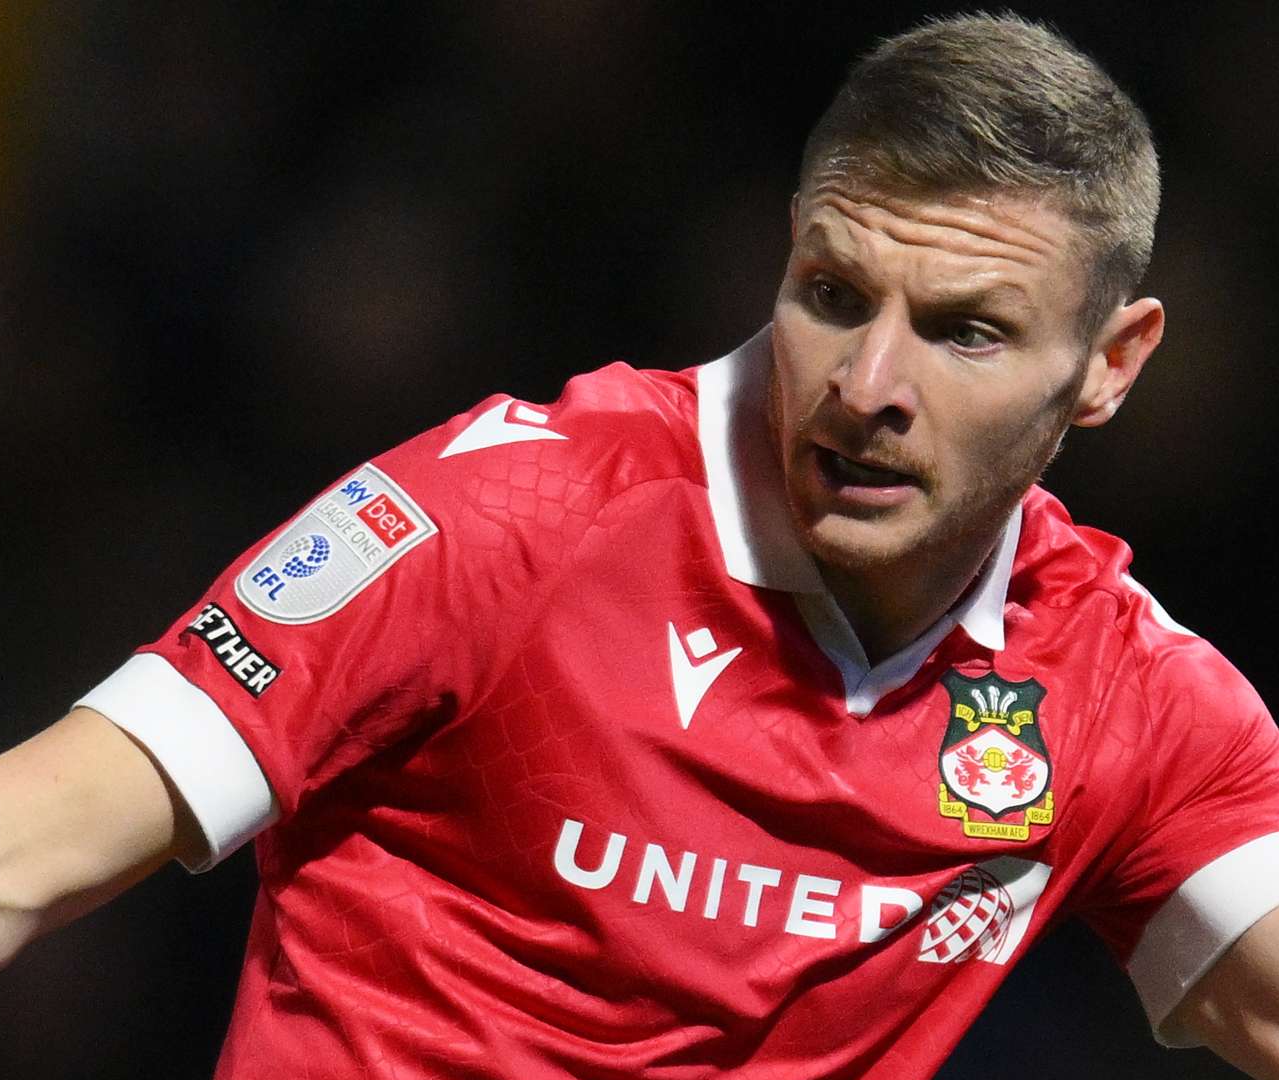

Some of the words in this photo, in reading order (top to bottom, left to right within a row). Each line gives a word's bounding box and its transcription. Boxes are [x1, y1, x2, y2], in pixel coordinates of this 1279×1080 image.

[340, 479, 374, 506] sky
[367, 498, 407, 540] bet
[350, 530, 382, 561] ONE
[252, 566, 286, 601] EFL
[188, 604, 277, 693] ETHER
[968, 825, 1008, 836] WREXHAM
[1009, 827, 1026, 838] AFC
[554, 819, 923, 943] UNITED
